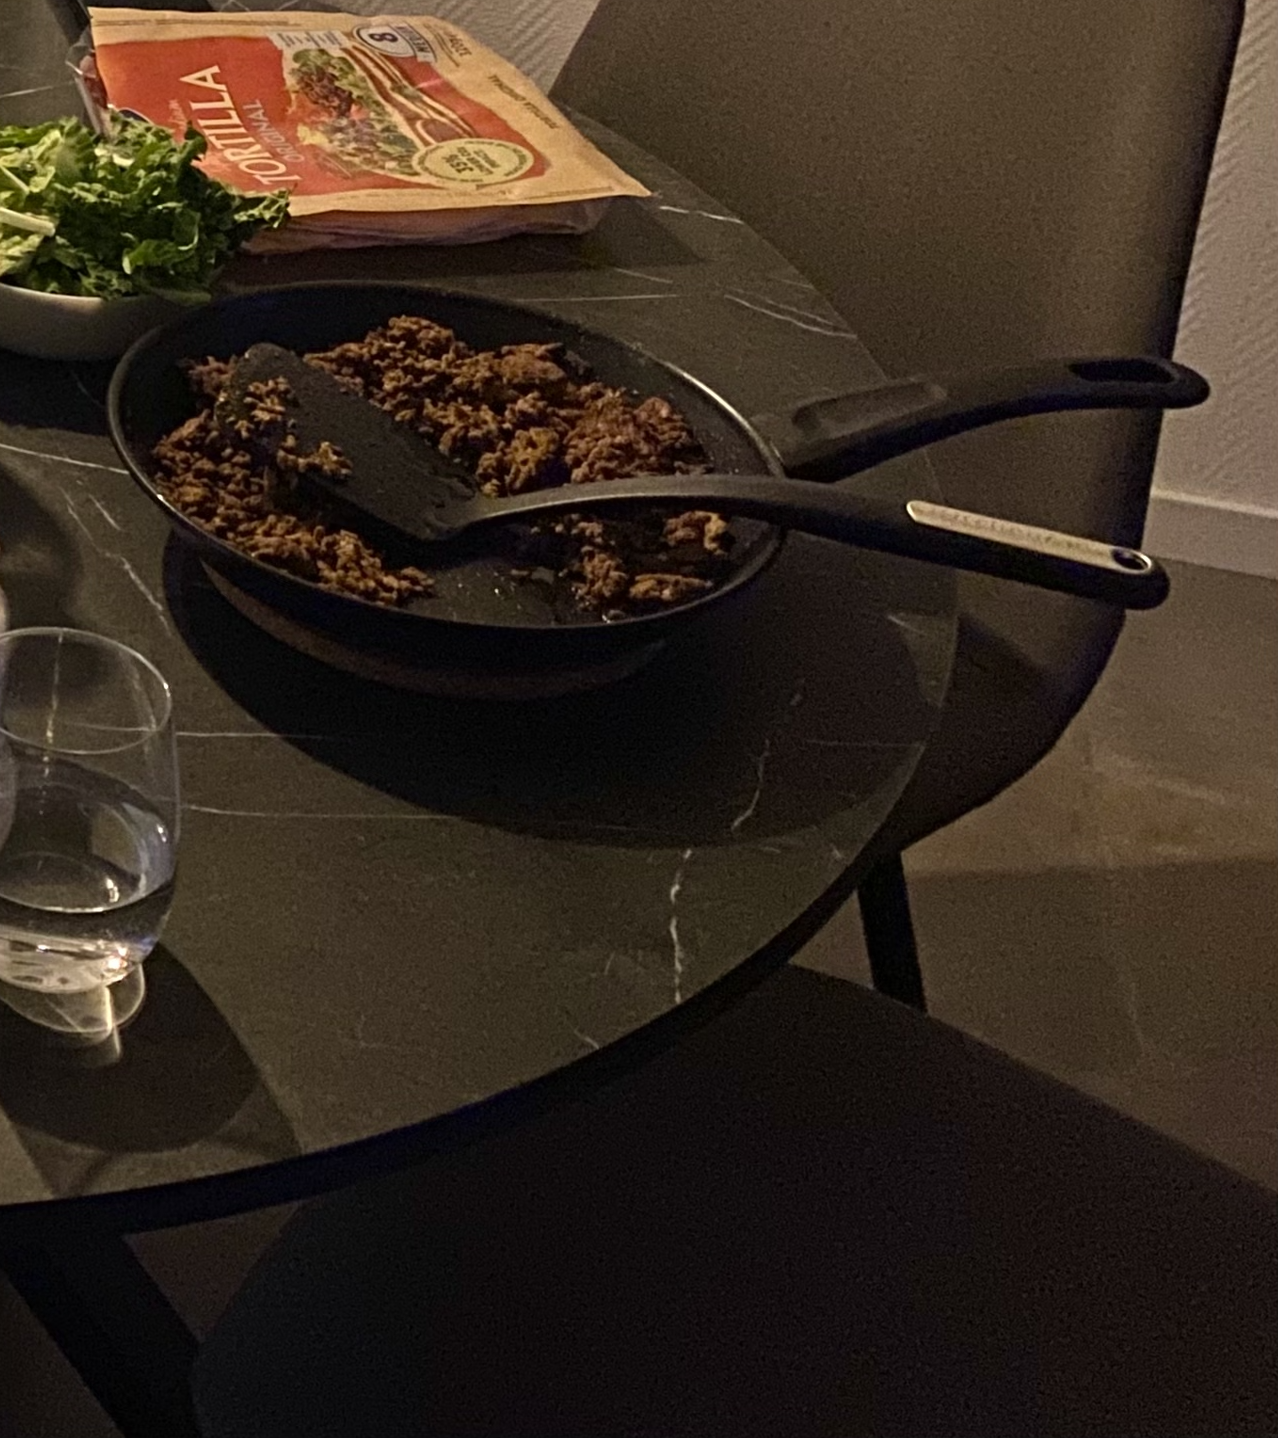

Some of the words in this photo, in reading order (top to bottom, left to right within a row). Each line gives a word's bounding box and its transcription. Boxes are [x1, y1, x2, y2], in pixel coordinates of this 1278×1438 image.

[367, 31, 399, 43] 8
[179, 64, 302, 185] TORTILLA
[242, 99, 305, 163] ORIGINAL
